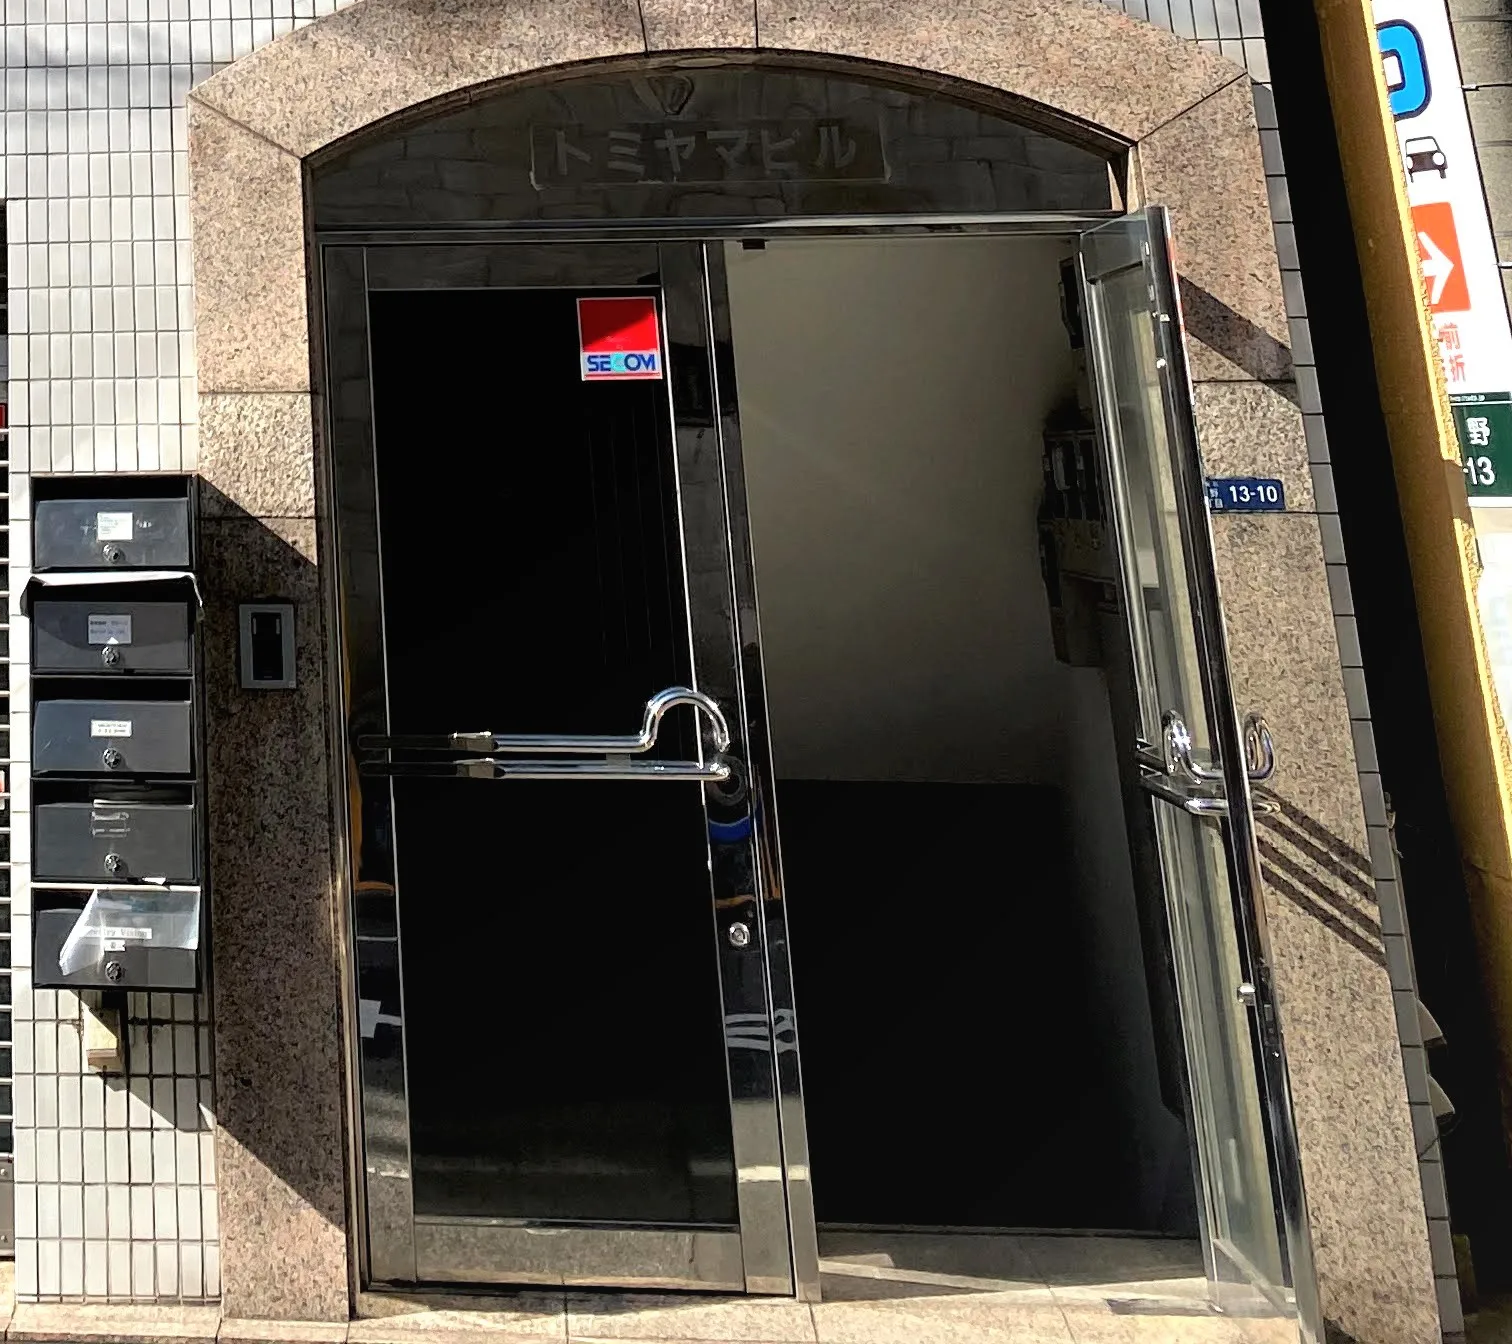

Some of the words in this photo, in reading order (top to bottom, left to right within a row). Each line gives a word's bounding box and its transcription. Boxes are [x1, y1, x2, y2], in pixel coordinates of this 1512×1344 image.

[553, 123, 857, 177] トミヤマビル
[587, 352, 657, 372] SECOM
[1229, 485, 1279, 503] 13-10
